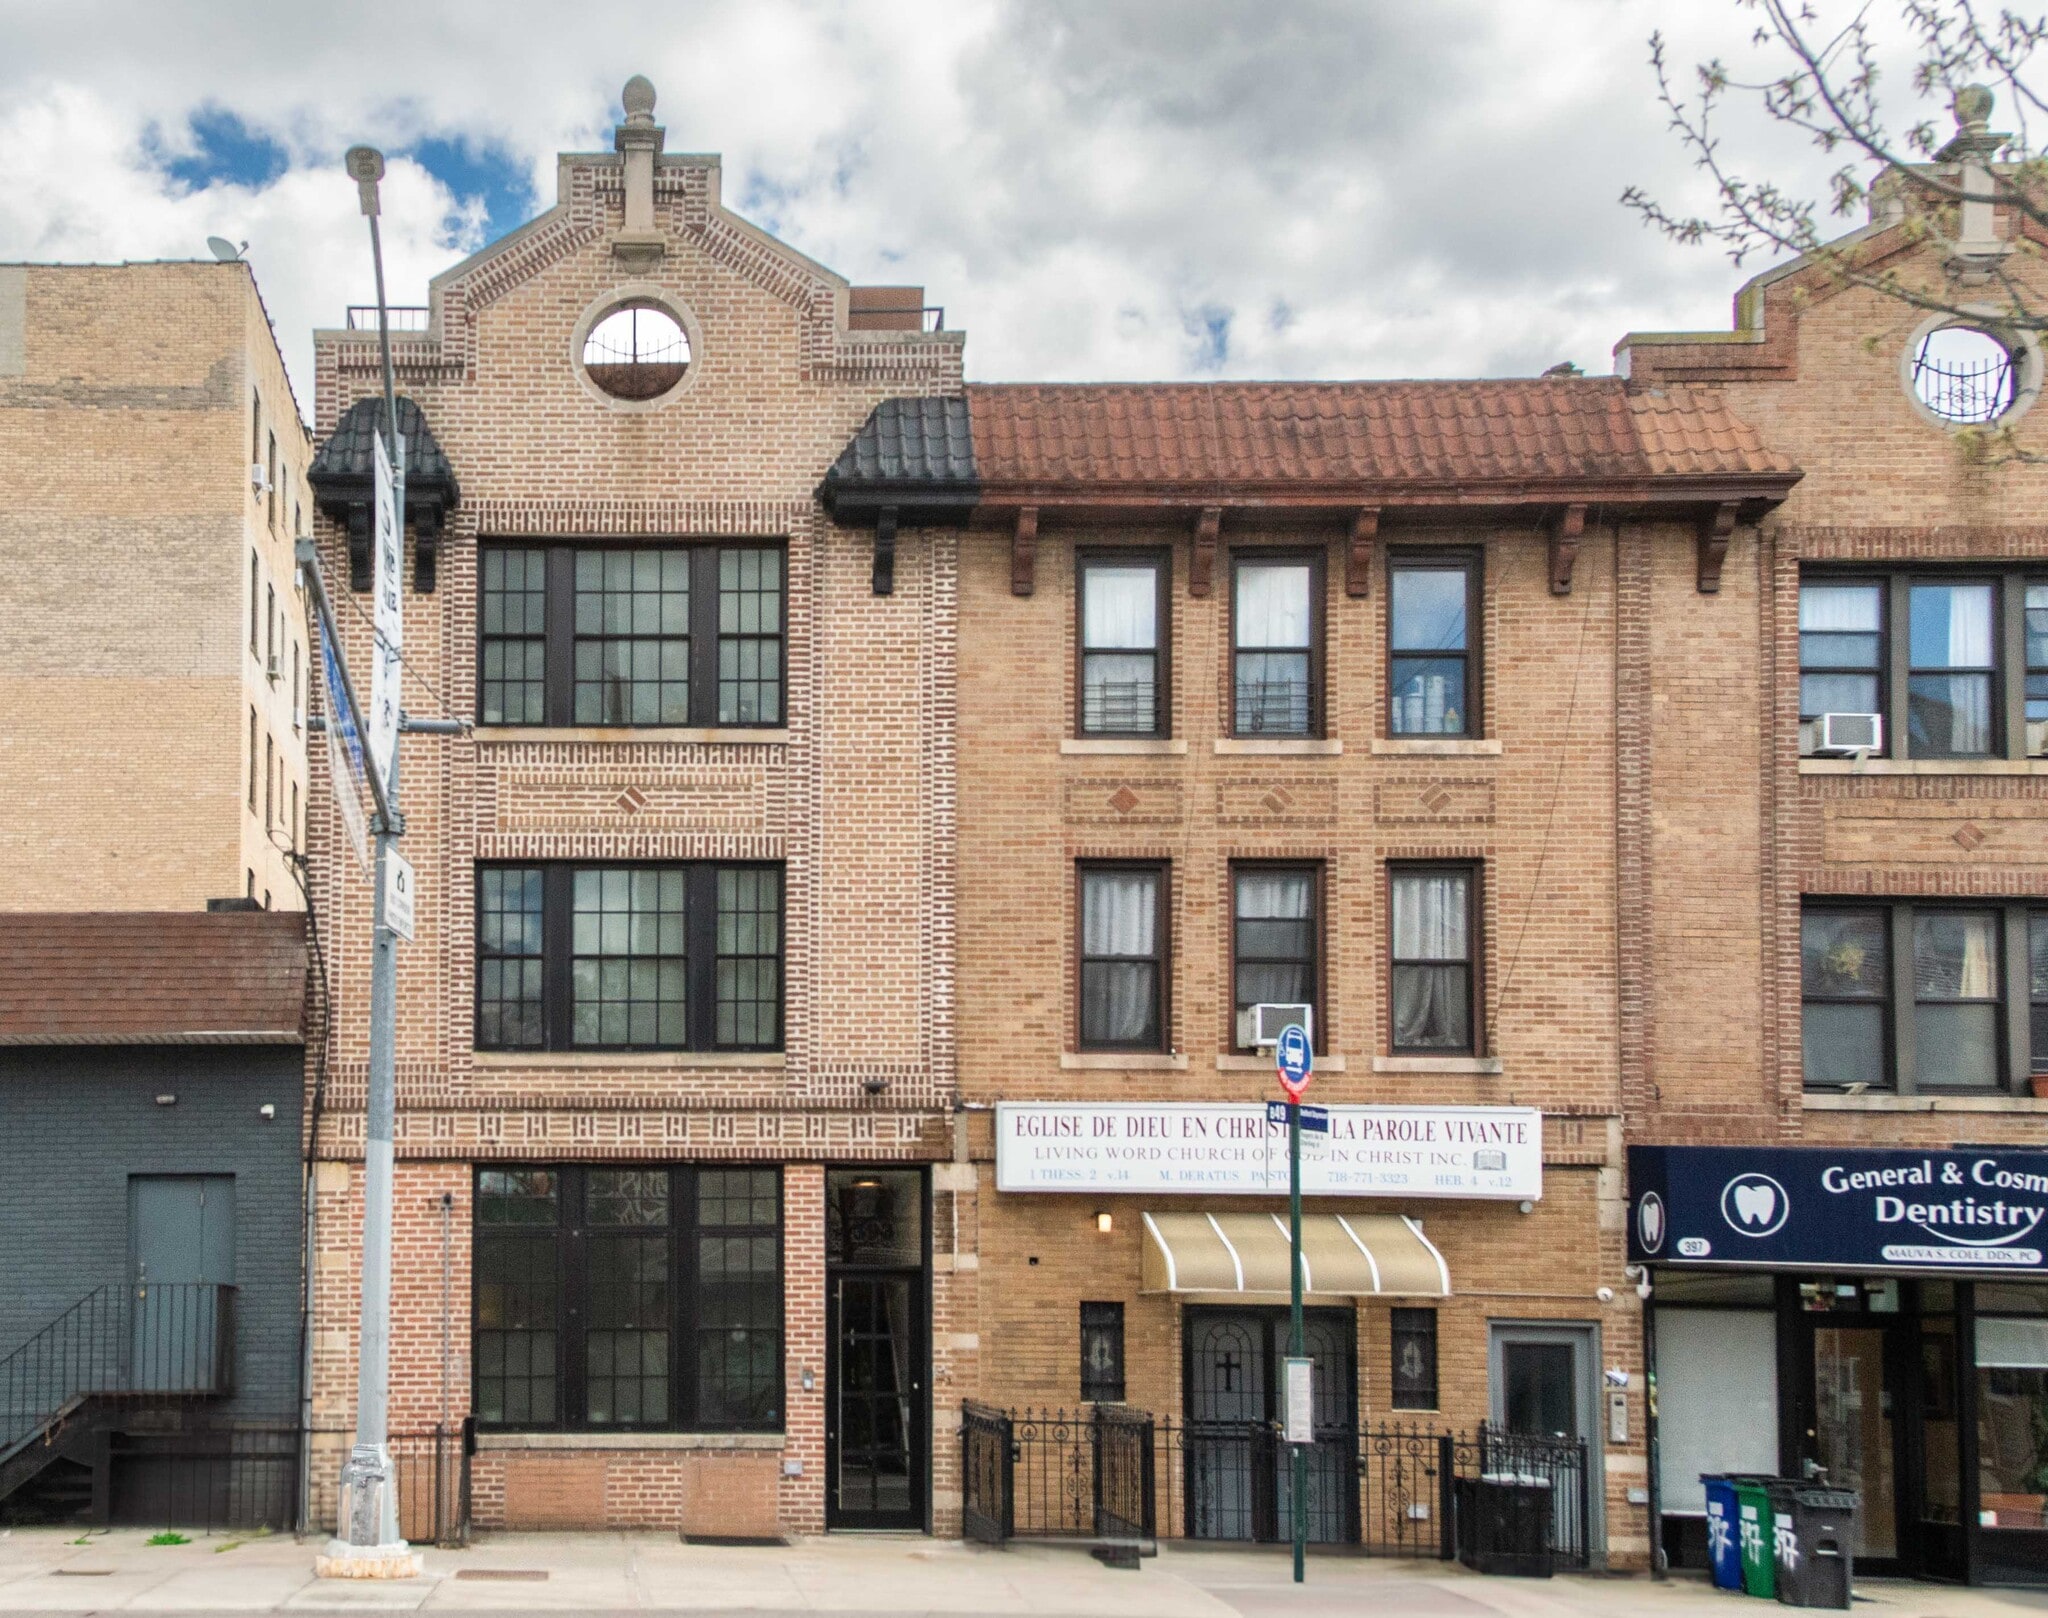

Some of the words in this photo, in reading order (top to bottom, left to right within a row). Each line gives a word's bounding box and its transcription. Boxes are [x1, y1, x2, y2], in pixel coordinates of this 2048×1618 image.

[1016, 1115, 1083, 1137] EGLISE
[1093, 1116, 1118, 1138] DE
[1126, 1116, 1172, 1138] DIEU
[1182, 1117, 1207, 1138] EN
[1332, 1120, 1356, 1140] LA
[1363, 1119, 1437, 1142] PAROLE
[1445, 1121, 1528, 1145] VIVANTE
[1034, 1147, 1098, 1161] LIVING
[1105, 1147, 1161, 1161] WORD
[1168, 1147, 1245, 1162] CHURCH
[1252, 1148, 1278, 1162] OF
[1331, 1151, 1349, 1162] IN
[1356, 1151, 1424, 1165] CHRIST
[1430, 1152, 1468, 1167] INC.
[1089, 1169, 1097, 1180] 2
[1178, 1170, 1239, 1181] DERATUS
[1327, 1172, 1408, 1185] 718-771-3323
[1821, 1159, 1932, 1193] General
[1940, 1161, 1964, 1185] &
[1876, 1196, 2044, 1226] Dentistry
[1685, 1240, 1704, 1253] 397
[1887, 1248, 1933, 1259] MAUVA
[2019, 1251, 2036, 1262] PC
